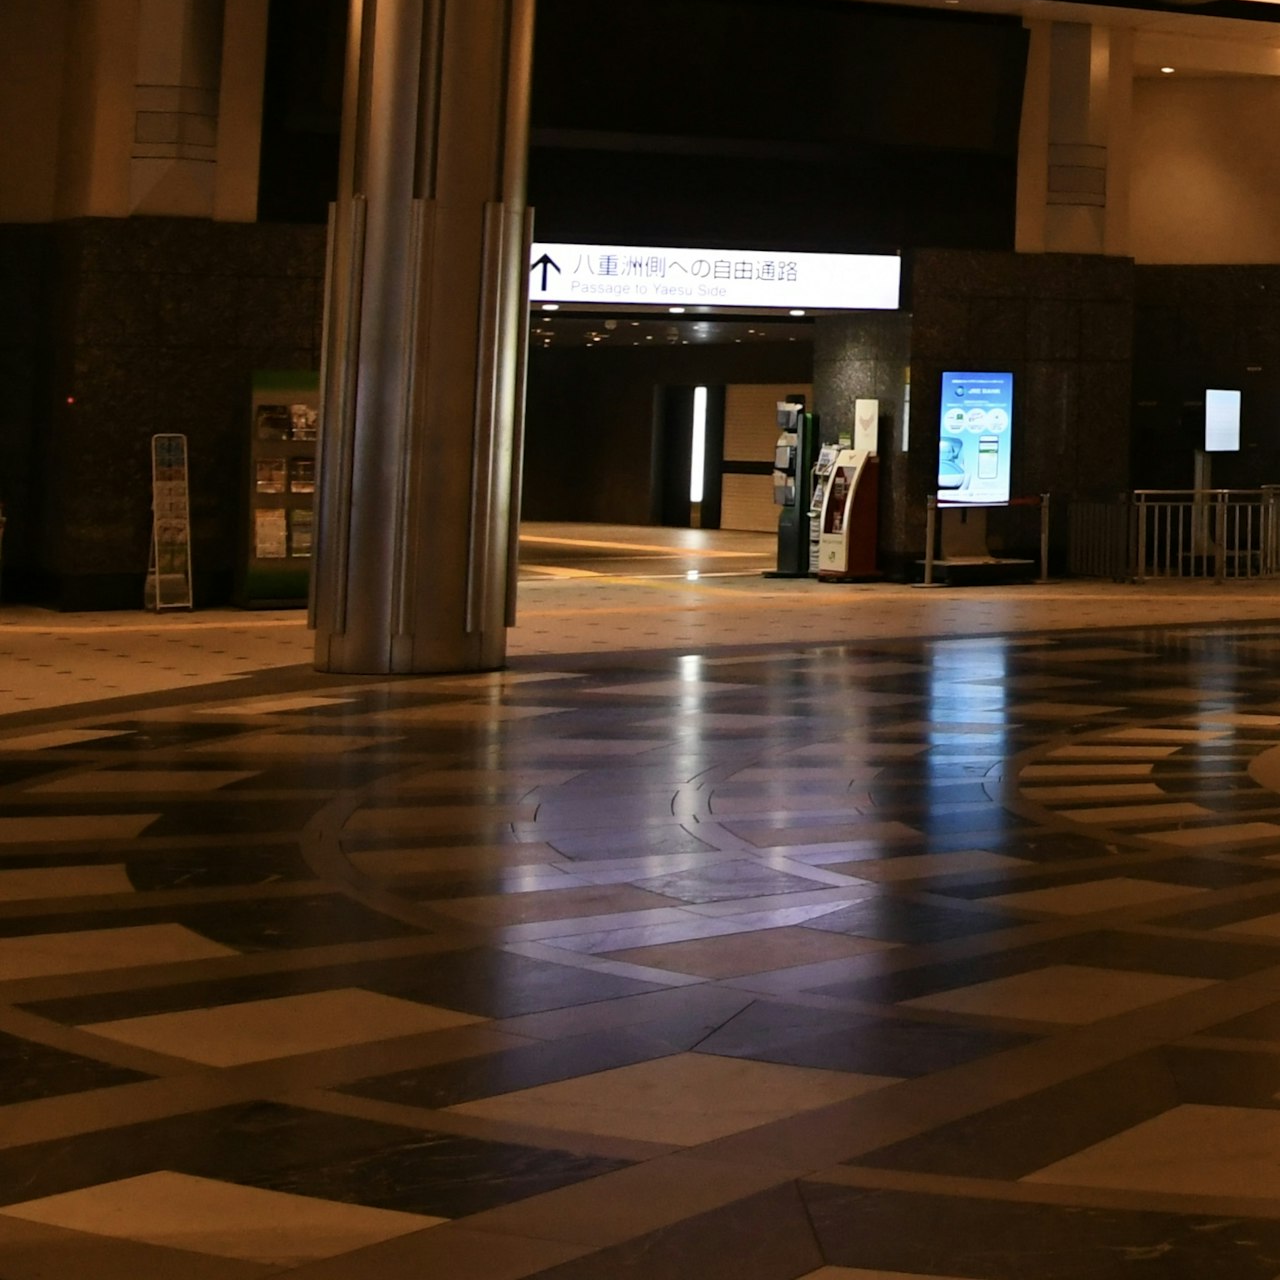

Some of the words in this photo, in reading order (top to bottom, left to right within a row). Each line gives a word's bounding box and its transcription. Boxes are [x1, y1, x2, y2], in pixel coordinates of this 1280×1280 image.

[573, 253, 799, 282] 八重洲側への自由通路
[570, 279, 630, 297] Passage
[635, 283, 648, 295] to
[652, 283, 693, 297] Yaesu
[698, 285, 727, 297] Side
